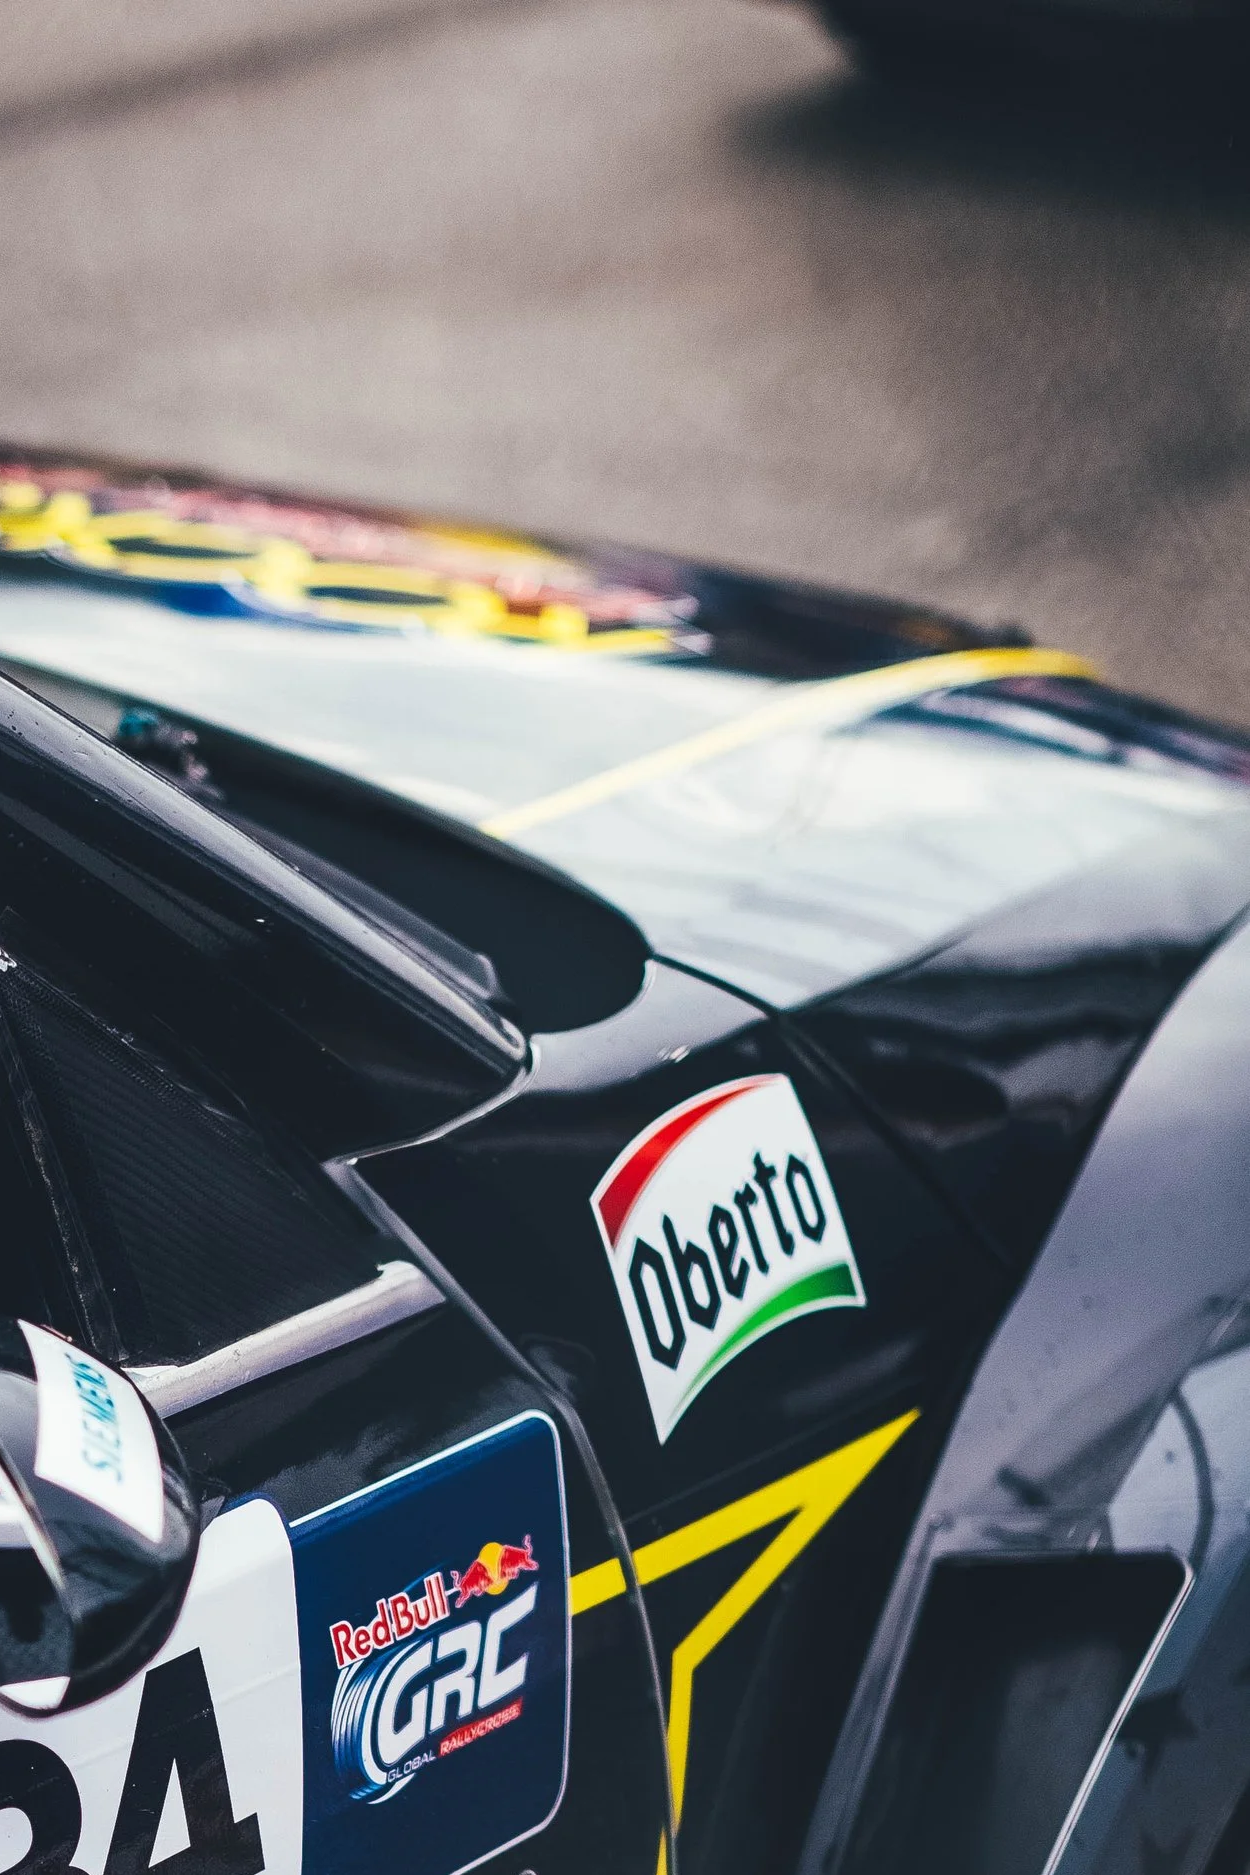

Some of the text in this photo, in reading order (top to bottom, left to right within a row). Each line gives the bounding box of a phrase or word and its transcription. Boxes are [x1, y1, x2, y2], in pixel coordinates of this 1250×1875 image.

[627, 1151, 828, 1372] Oberto
[378, 1581, 539, 1766] GRC
[439, 1702, 522, 1757] RALLYCROSS
[386, 1750, 438, 1783] GLOBAL
